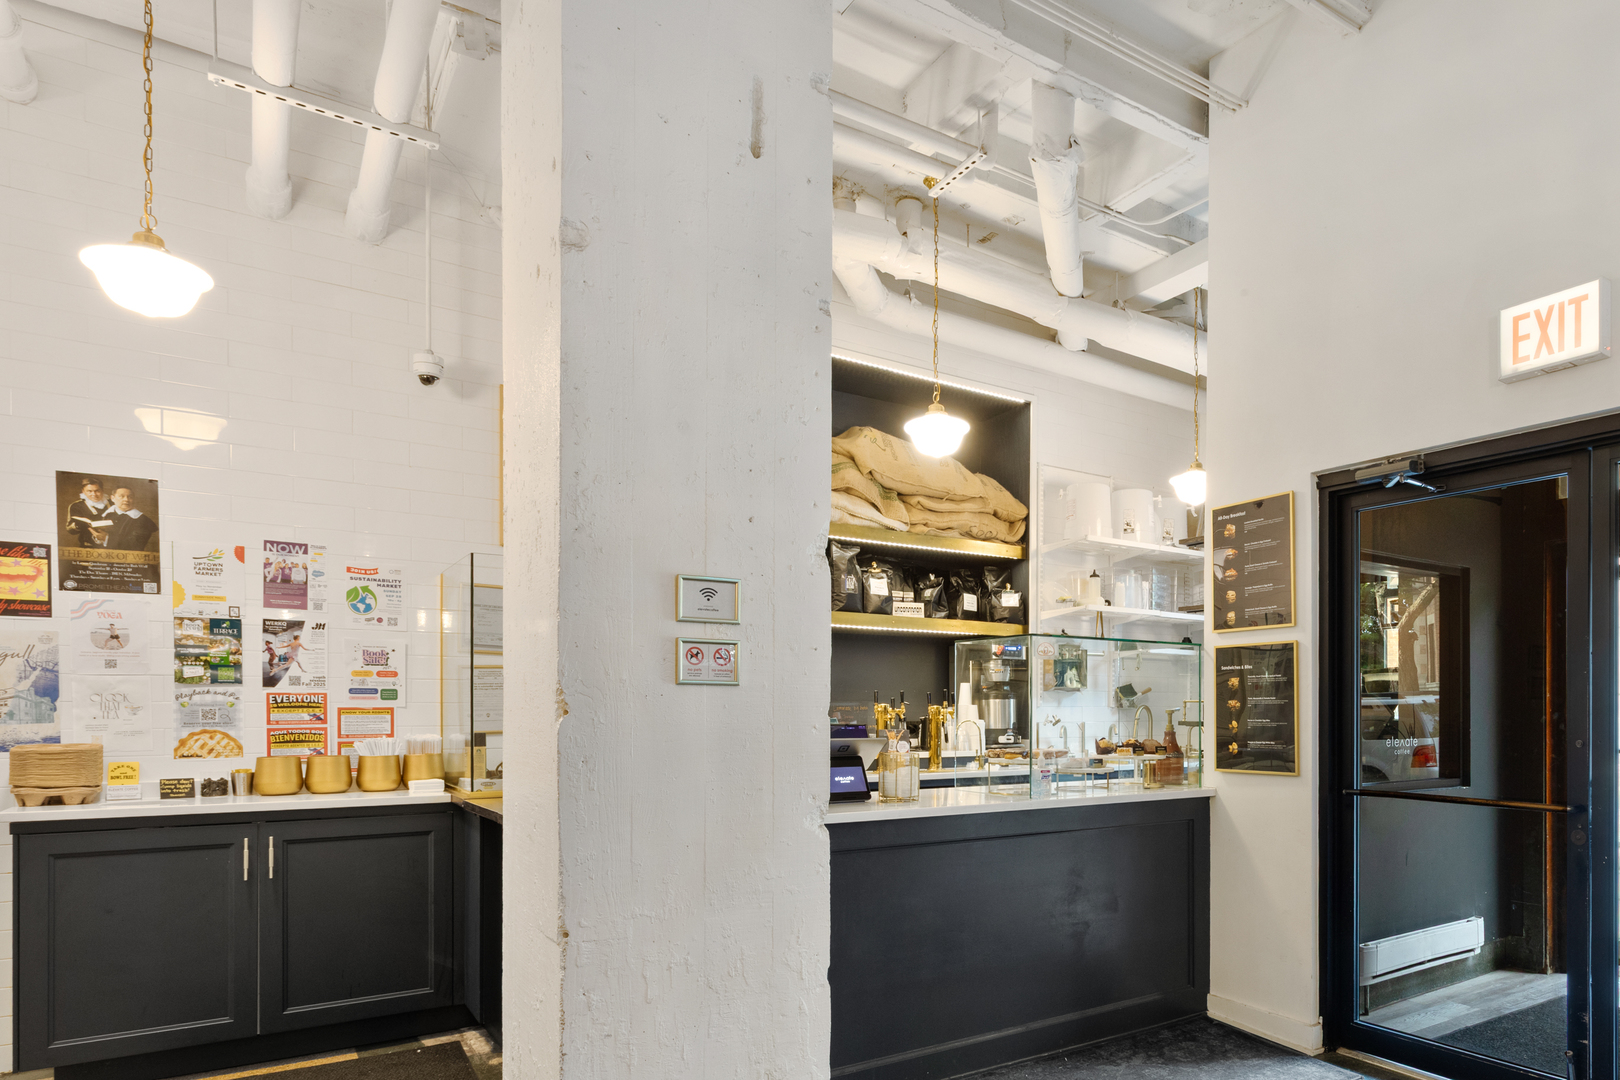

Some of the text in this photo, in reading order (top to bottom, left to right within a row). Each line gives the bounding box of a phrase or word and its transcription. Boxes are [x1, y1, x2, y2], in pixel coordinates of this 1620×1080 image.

[1512, 293, 1589, 366] EXIT
[7, 546, 30, 558] like
[266, 542, 306, 554] NOW
[61, 549, 160, 562] THE BOOK OF WILL
[8, 599, 50, 612] showcase
[96, 612, 122, 620] YOGA
[0, 644, 35, 667] gull
[175, 688, 212, 701] Playback
[228, 692, 241, 700] Pie
[270, 694, 325, 704] EVERYONE
[270, 733, 325, 743] BIENVENIDOS
[110, 764, 125, 773] TAKE
